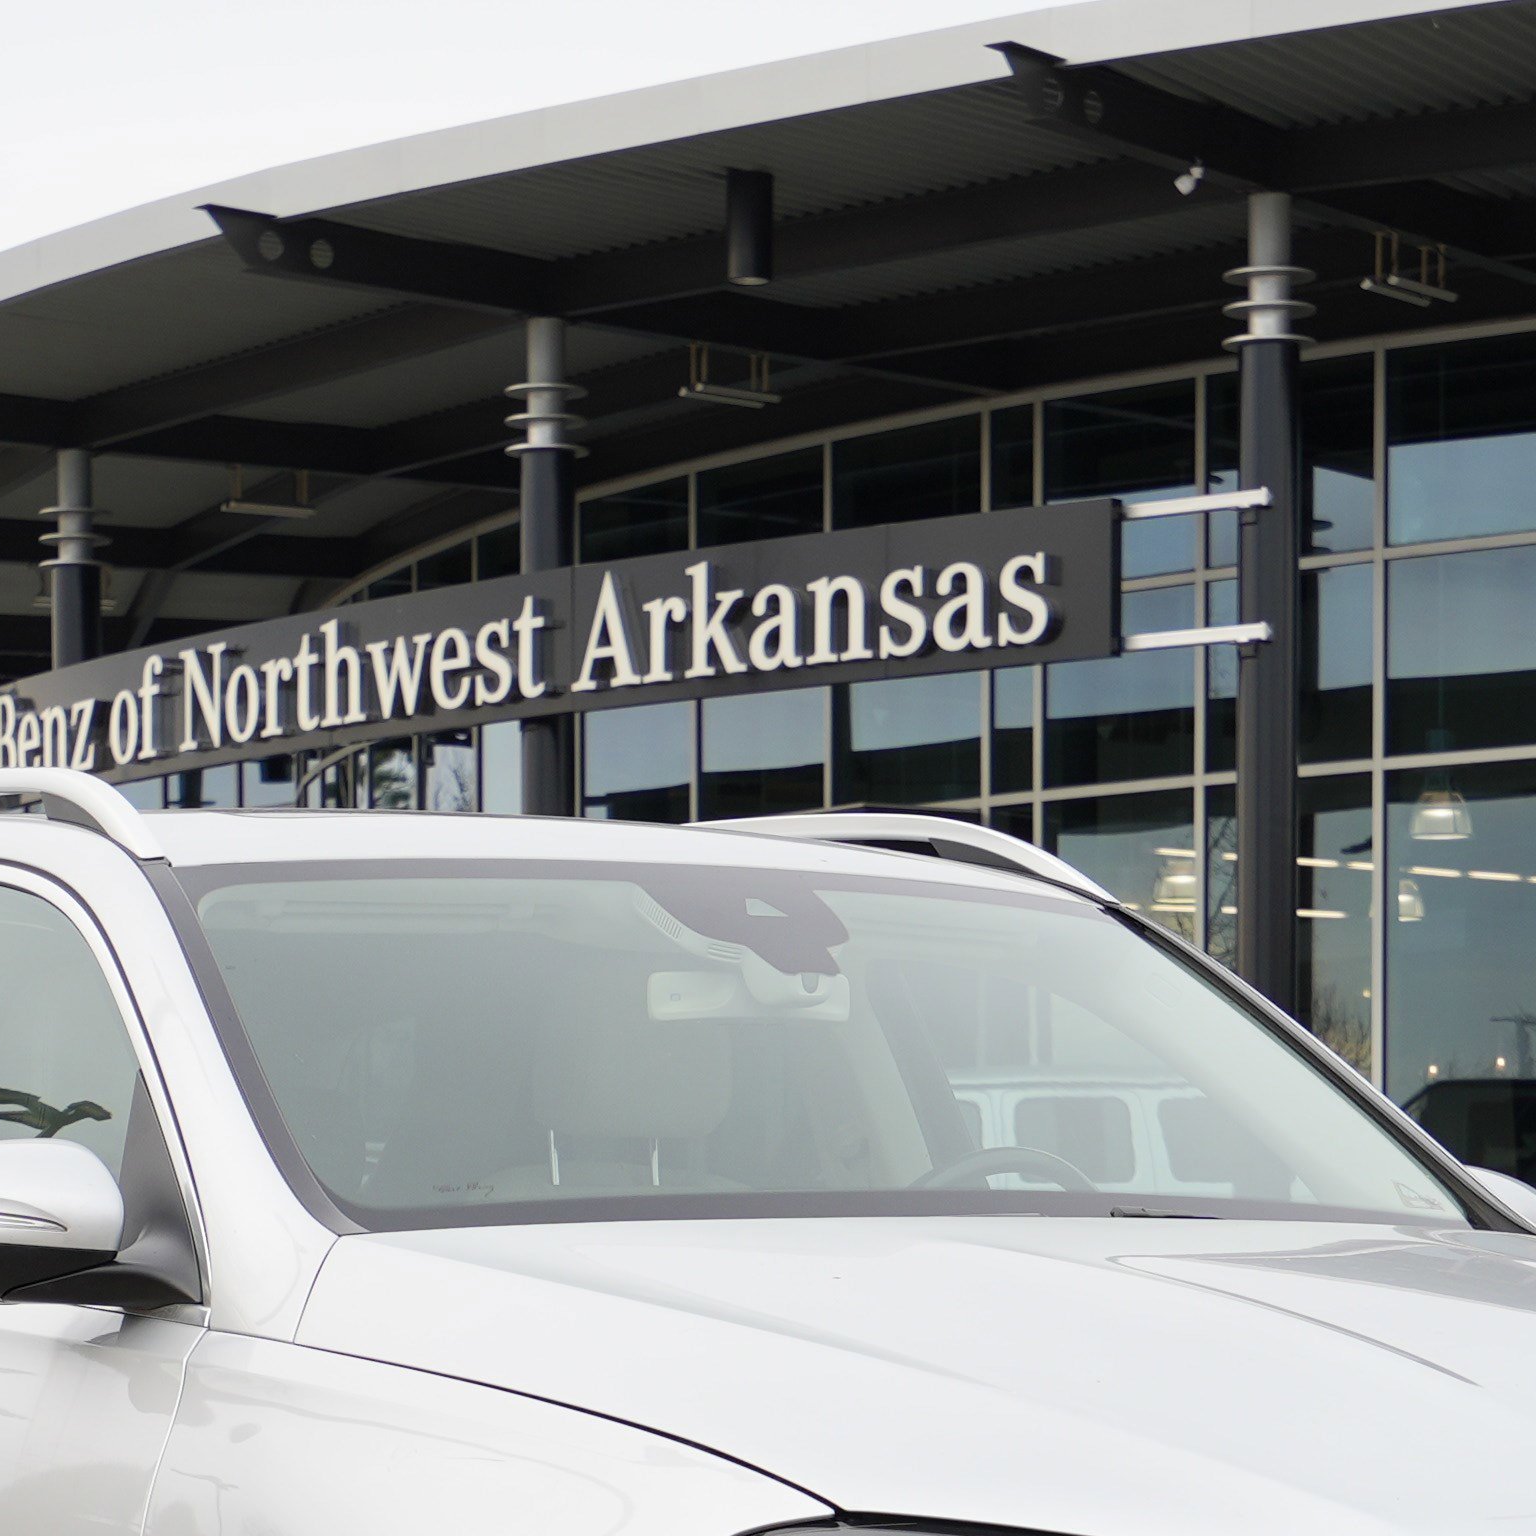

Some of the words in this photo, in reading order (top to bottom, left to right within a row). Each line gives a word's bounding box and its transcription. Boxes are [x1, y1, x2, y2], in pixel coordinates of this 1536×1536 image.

[108, 653, 164, 766] of
[177, 594, 546, 753] Northwest
[572, 550, 1052, 694] Arkansas
